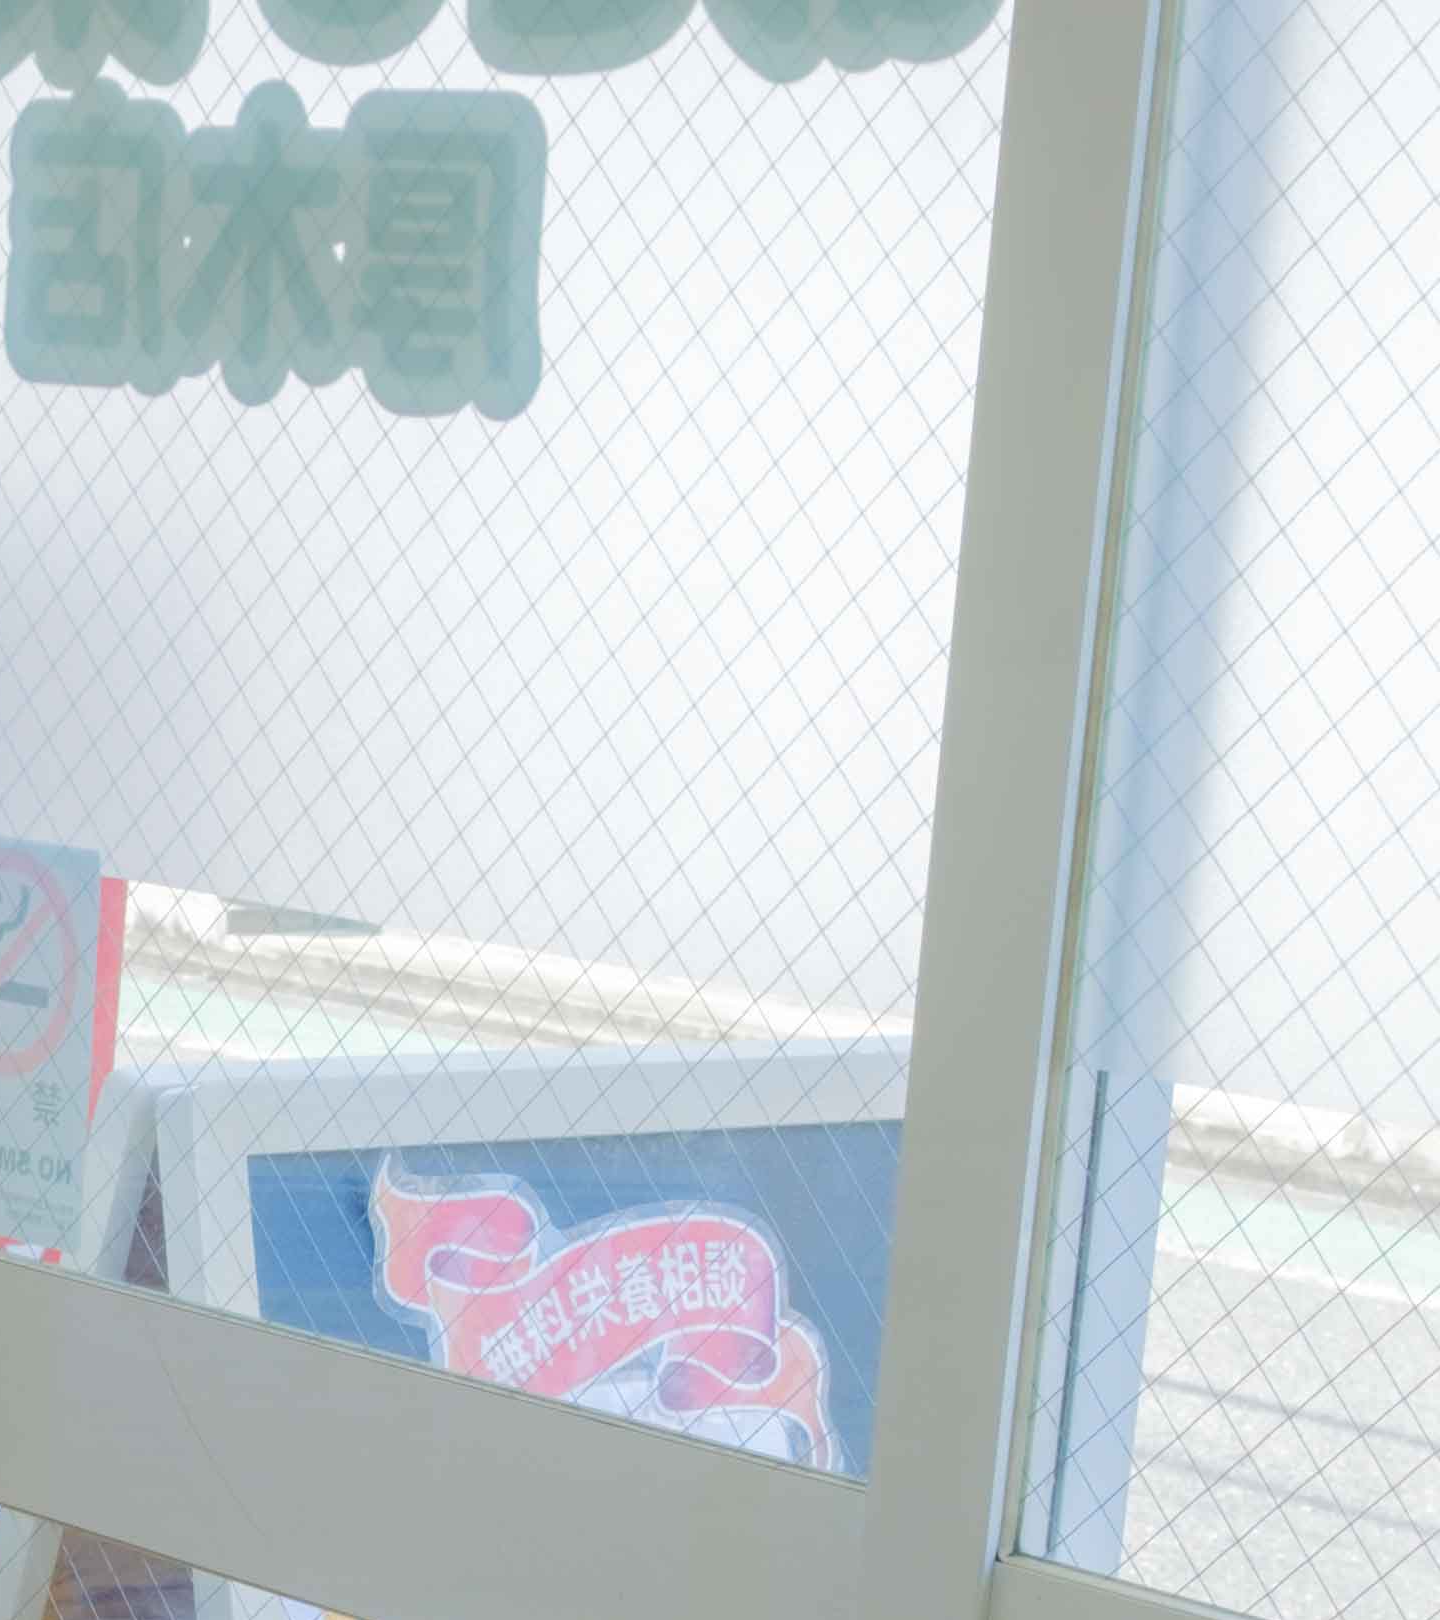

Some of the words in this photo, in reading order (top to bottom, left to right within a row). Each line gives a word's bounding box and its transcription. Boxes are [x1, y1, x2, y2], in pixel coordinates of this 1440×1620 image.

[481, 1239, 750, 1389] 無料栄養相談
